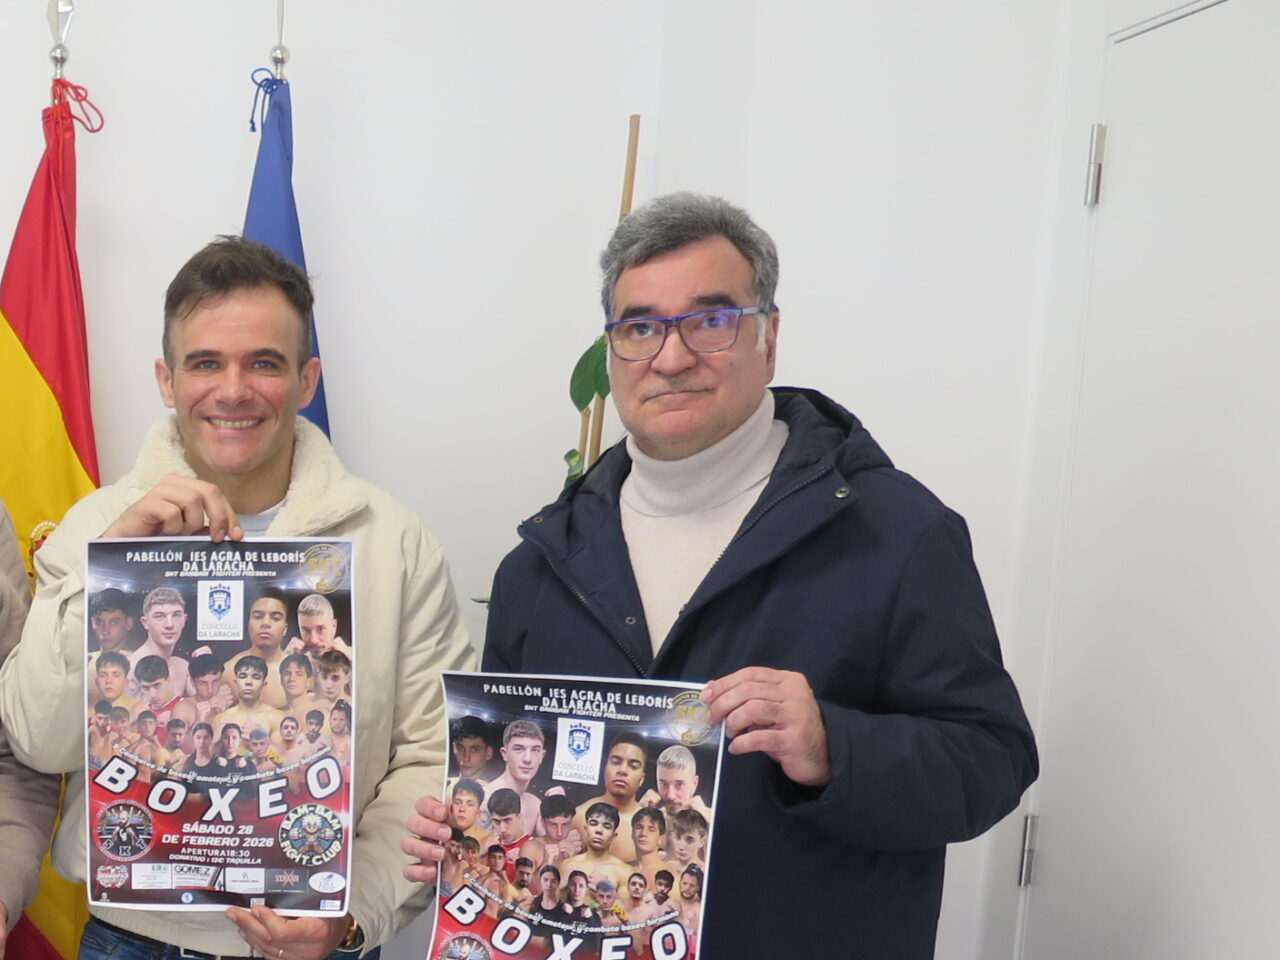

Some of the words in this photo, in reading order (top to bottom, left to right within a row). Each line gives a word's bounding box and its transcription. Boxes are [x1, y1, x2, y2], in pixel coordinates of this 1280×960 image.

[190, 551, 207, 562] IES
[210, 550, 241, 562] AGRA
[245, 552, 258, 562] DE
[261, 550, 306, 563] LEBORÍS
[183, 561, 199, 571] DA
[202, 561, 254, 571] LARACHA
[542, 697, 559, 708] DA
[562, 698, 616, 713] LARACHA
[549, 688, 567, 699] IES
[570, 689, 602, 702] AGRA
[606, 692, 622, 704] DE
[625, 694, 674, 709] LEBORÍS
[156, 765, 168, 774] de
[276, 762, 300, 775] boxeo
[558, 762, 594, 773] CONCELLO
[554, 769, 564, 778] DA
[565, 771, 596, 783] LARACHA
[93, 755, 342, 822] BOXEO
[282, 804, 342, 831] BAM-BAM
[181, 821, 234, 835] SÁBADO
[237, 825, 254, 835] 28
[102, 838, 147, 857] SKT
[161, 834, 180, 845] DE
[182, 835, 240, 848] FEBRERO
[242, 837, 274, 848] 2026
[169, 854, 206, 862] DONATIVO
[226, 857, 262, 865] TAQUILLA
[279, 840, 311, 866] FIGHT
[312, 840, 343, 866] CLUB
[173, 864, 210, 874] GOMEZ
